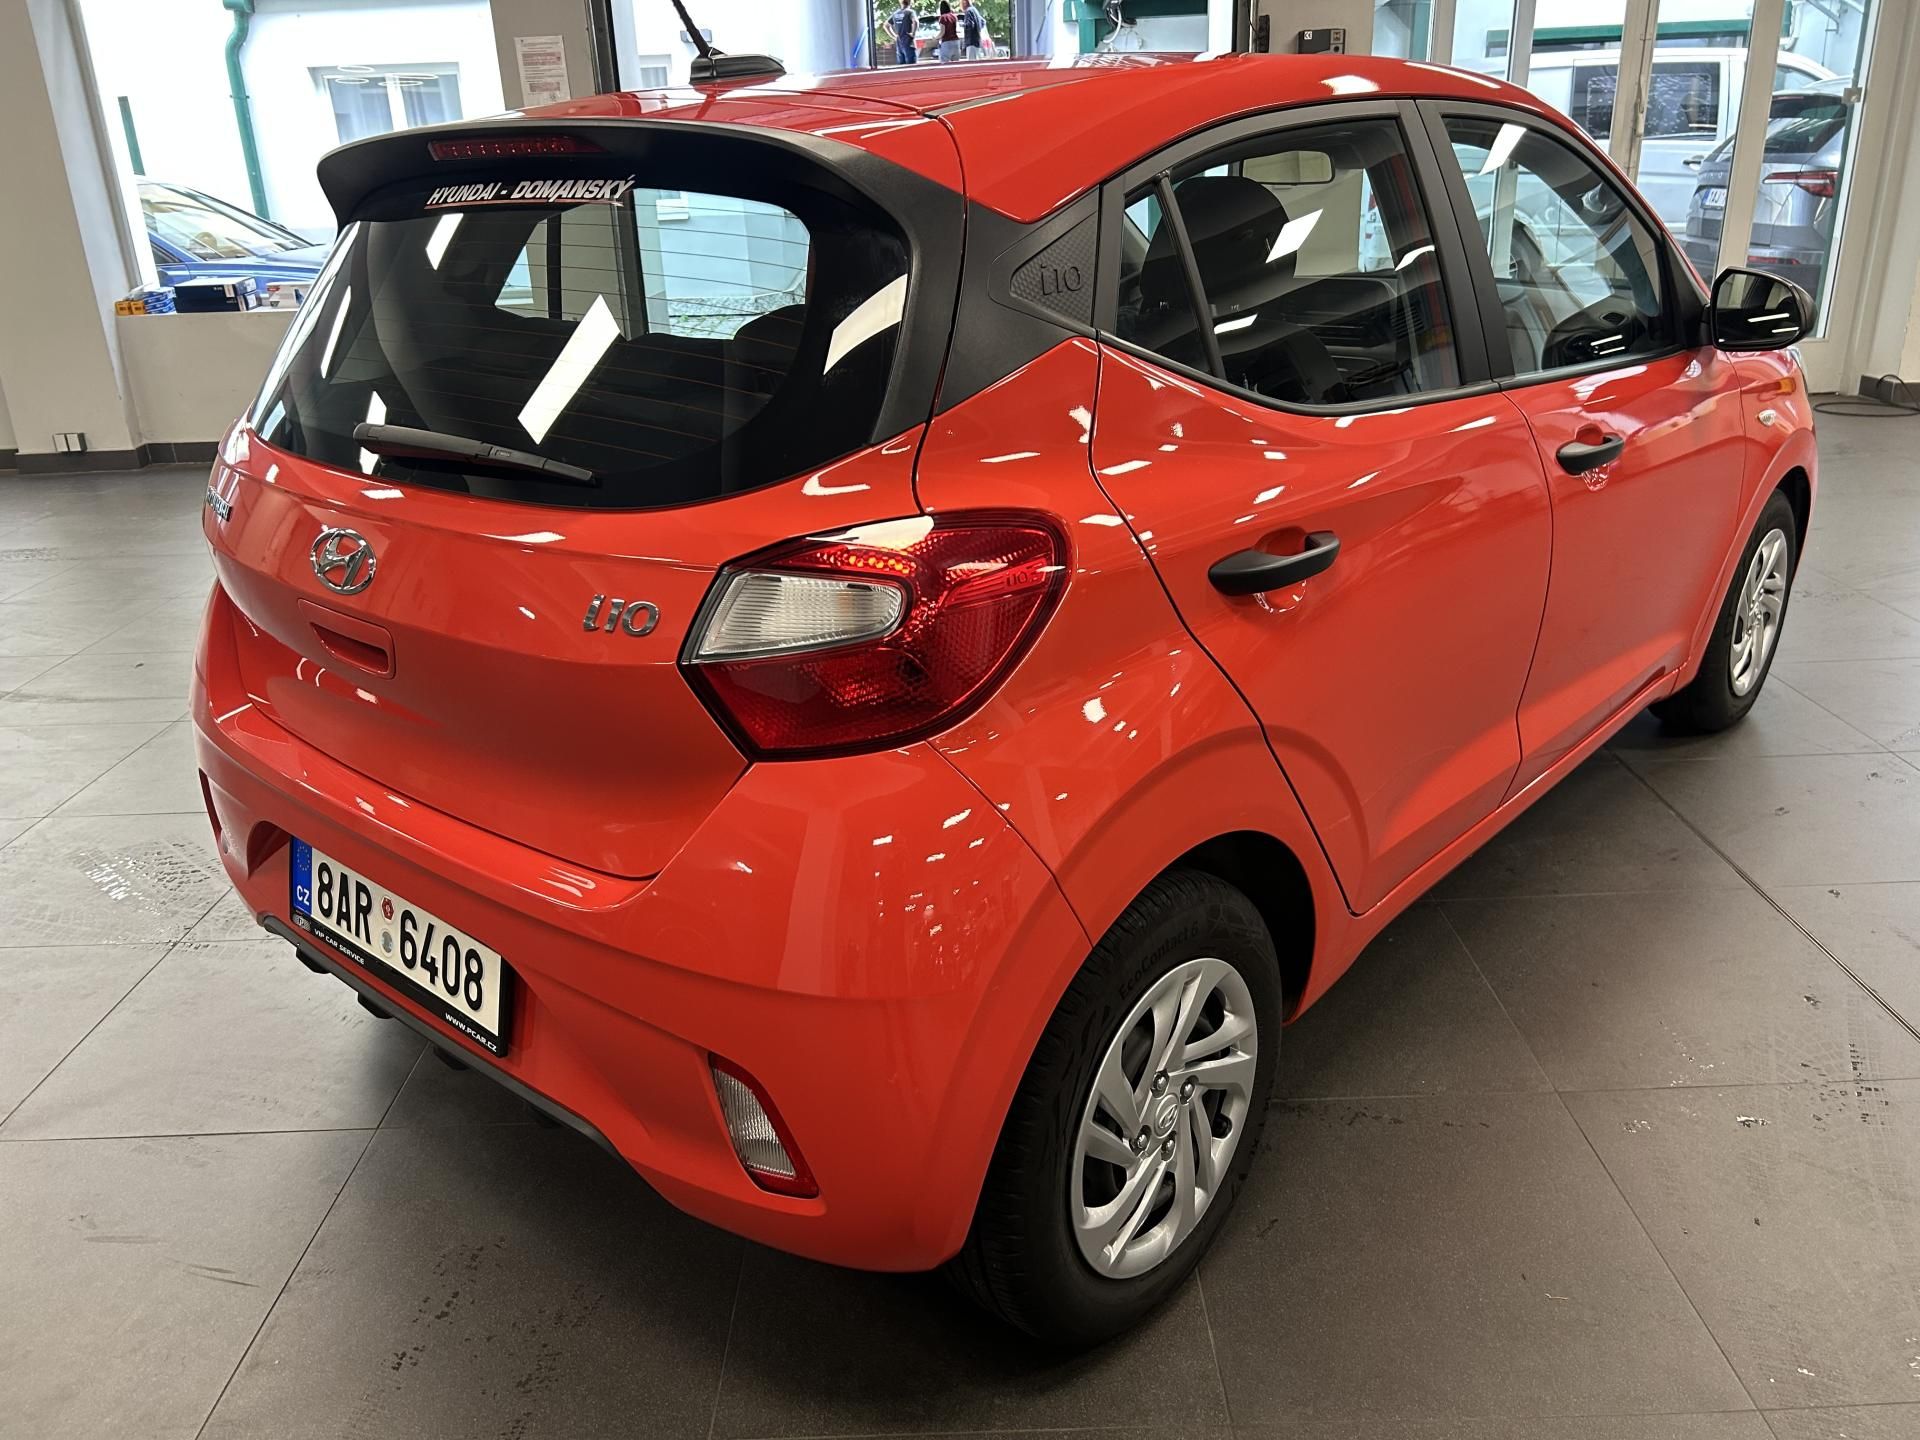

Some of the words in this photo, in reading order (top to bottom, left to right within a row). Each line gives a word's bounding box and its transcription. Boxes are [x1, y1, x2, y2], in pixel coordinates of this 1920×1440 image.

[426, 182, 502, 205] HYUNDAI
[510, 174, 636, 202] DOMANSKÝ
[583, 593, 660, 637] i10
[296, 885, 310, 906] CZ
[314, 929, 324, 938] VIP
[325, 935, 338, 947] CAR
[339, 944, 365, 965] SERVICE
[317, 862, 373, 945] 8AR
[400, 909, 484, 1011] 6408
[1119, 926, 1189, 1001] EcoContact
[1191, 920, 1199, 938] 6
[445, 1012, 497, 1053] WWW.PCAR.CZ
